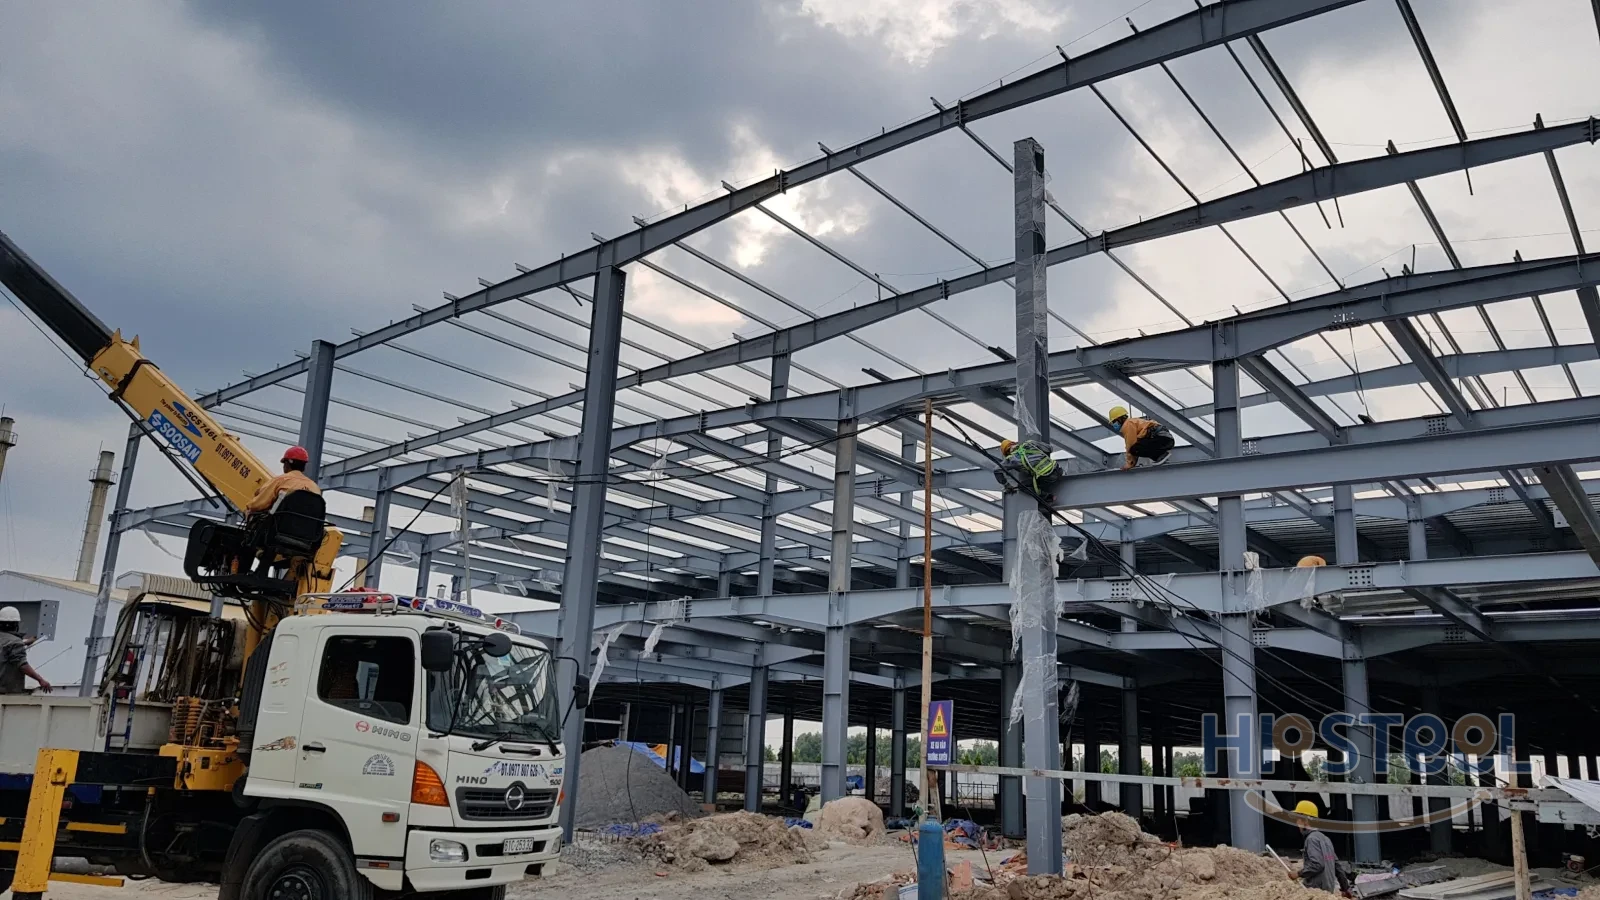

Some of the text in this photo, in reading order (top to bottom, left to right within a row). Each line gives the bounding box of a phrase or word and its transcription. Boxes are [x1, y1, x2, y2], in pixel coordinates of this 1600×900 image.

[160, 422, 200, 460] SOOSAN
[372, 725, 411, 742] HINO
[456, 776, 488, 785] HINO
